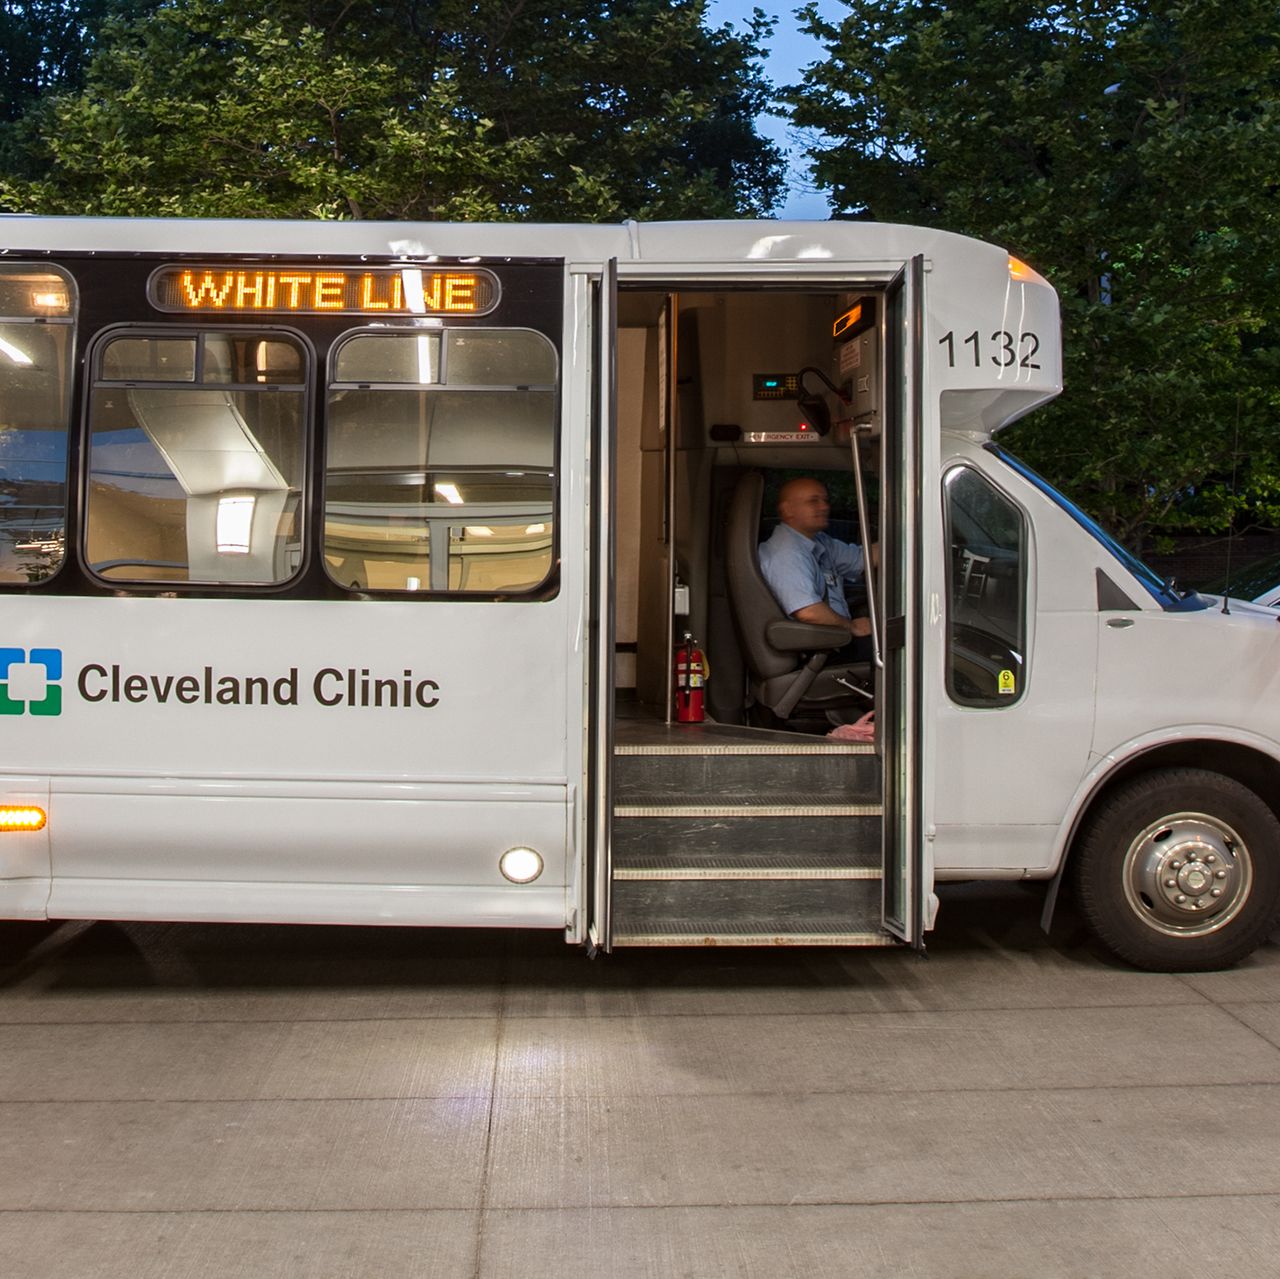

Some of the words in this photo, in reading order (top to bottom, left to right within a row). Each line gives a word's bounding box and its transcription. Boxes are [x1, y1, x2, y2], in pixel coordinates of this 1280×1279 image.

[183, 270, 345, 308] WHITE
[363, 272, 476, 310] LINE
[938, 330, 1041, 370] 1132
[77, 663, 299, 706] Cleveland
[312, 667, 441, 709] Clinic
